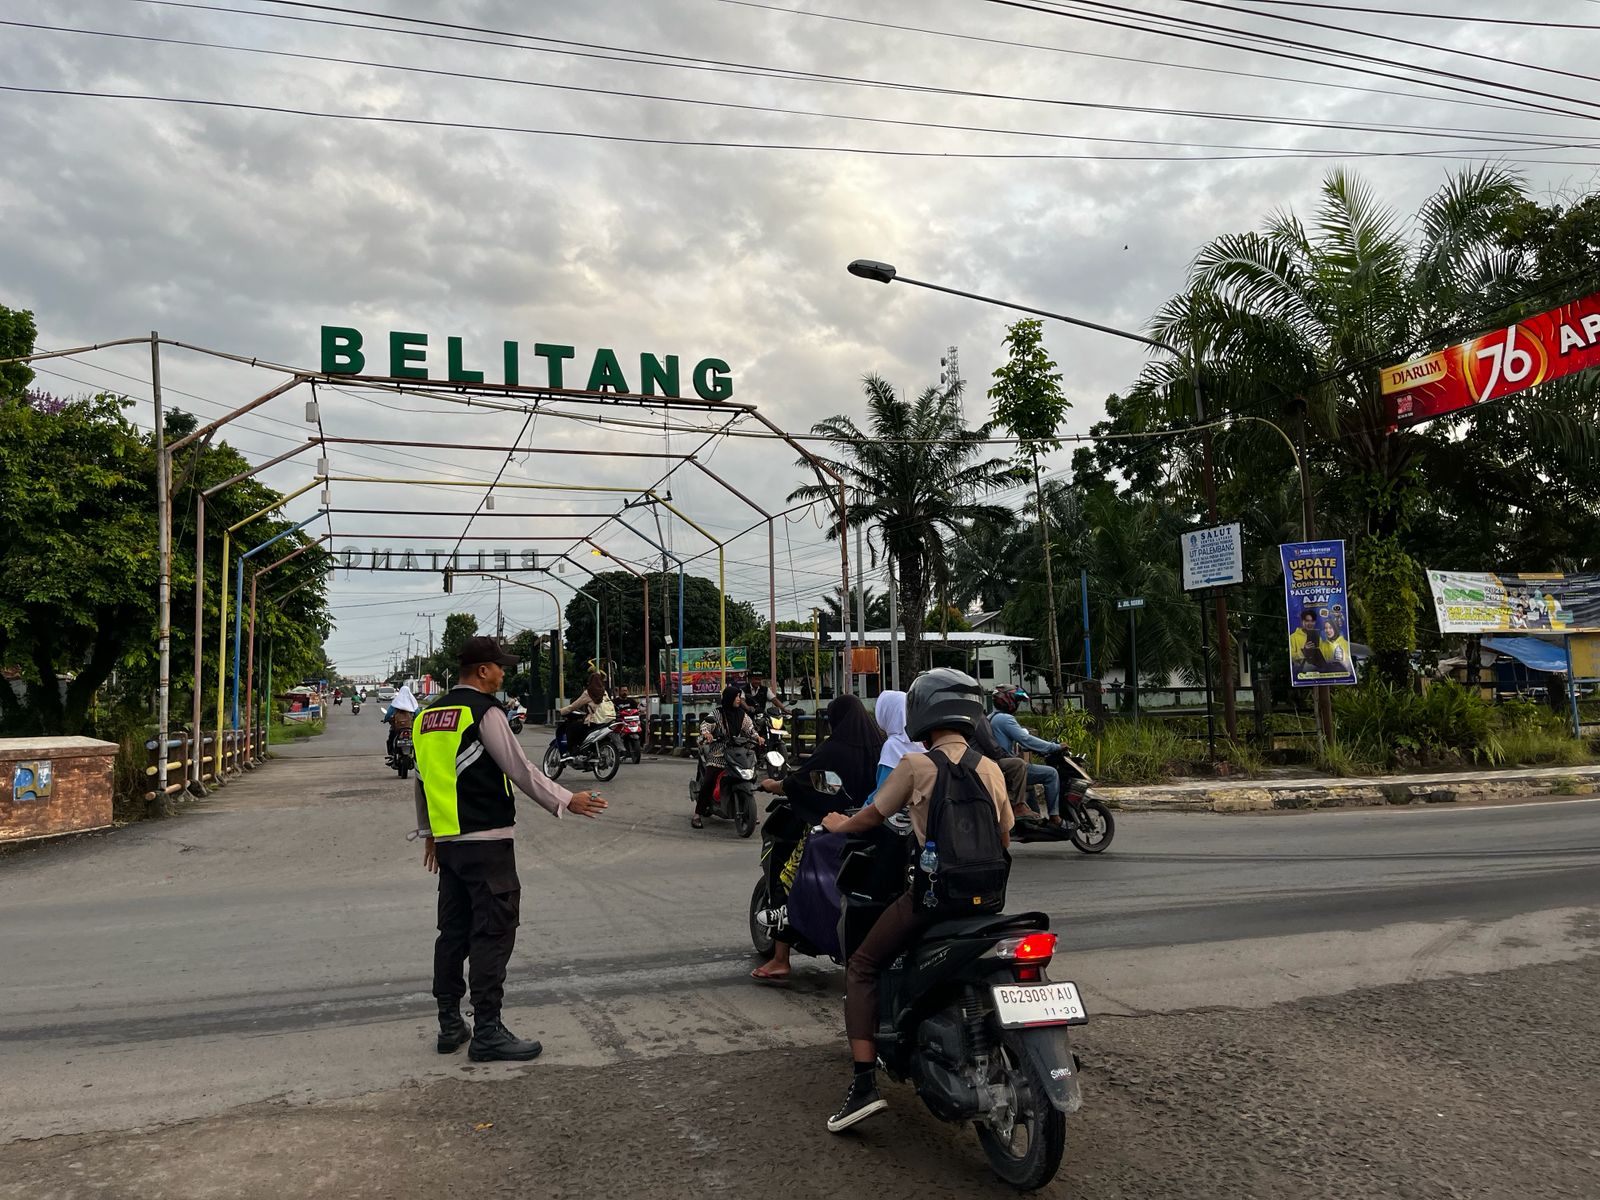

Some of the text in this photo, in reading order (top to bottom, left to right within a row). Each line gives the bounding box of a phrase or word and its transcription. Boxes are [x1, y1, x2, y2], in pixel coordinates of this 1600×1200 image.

[321, 325, 733, 401] BELITANG
[1392, 360, 1442, 385] DJARUM
[1476, 324, 1533, 404] 76
[1201, 527, 1231, 540] SALUT
[1190, 543, 1235, 558] UT PALEMBANG
[1290, 557, 1336, 570] UPDATE
[1293, 567, 1334, 581] SKILL
[1291, 580, 1319, 589] KODING
[1290, 587, 1342, 596] PALCOMTECH
[1303, 594, 1330, 604] AJA!
[421, 710, 457, 731] POLISI
